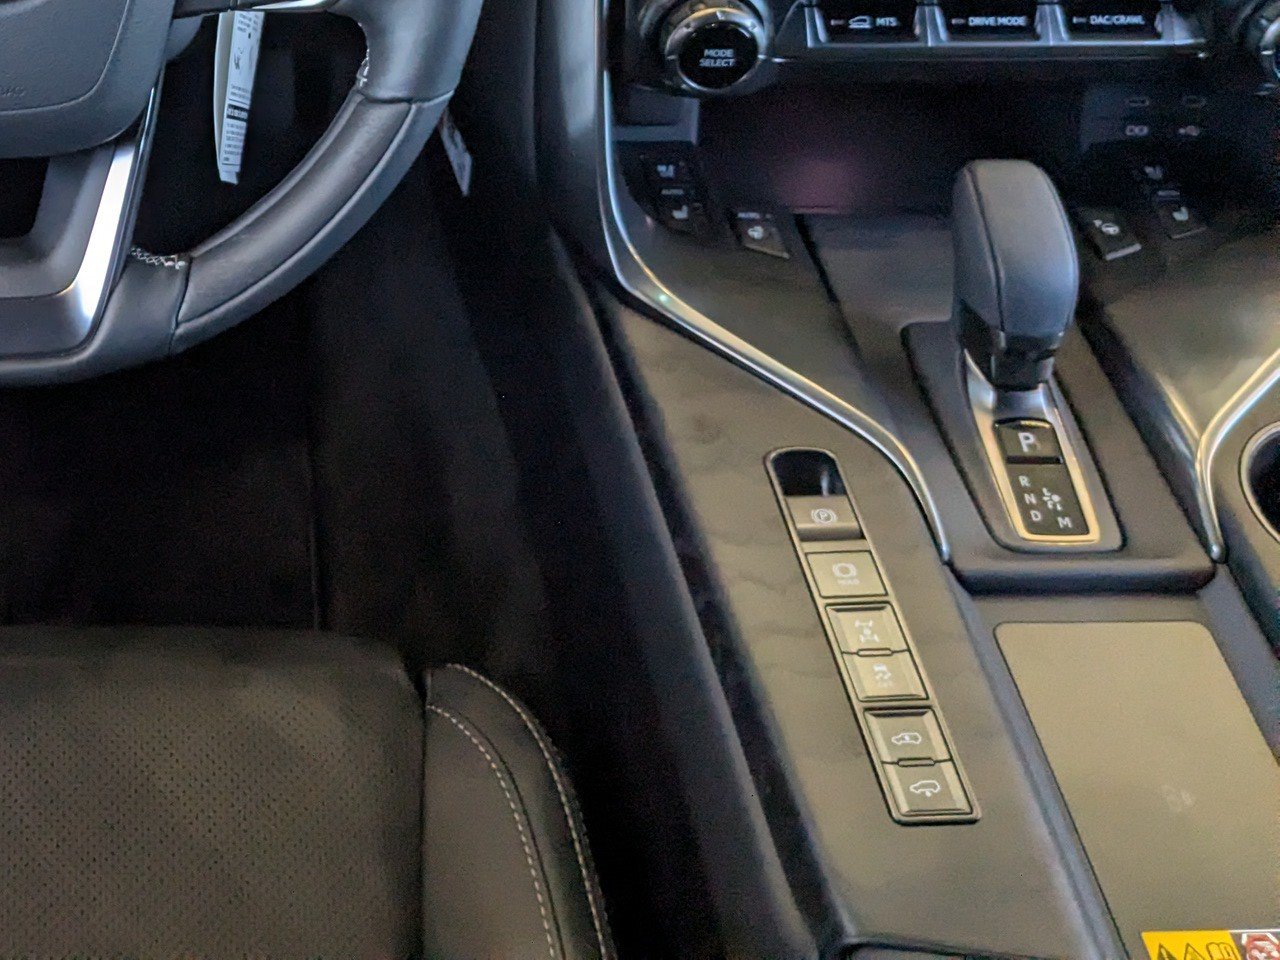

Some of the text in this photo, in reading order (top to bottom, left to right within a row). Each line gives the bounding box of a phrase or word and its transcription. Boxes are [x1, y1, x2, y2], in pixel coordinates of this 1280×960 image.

[876, 17, 897, 27] MTS
[968, 16, 1026, 27] DRIVE MODE
[1089, 15, 1145, 26] DAC/CRAWL
[704, 48, 734, 57] MODE
[699, 58, 736, 67] SELECT
[1018, 432, 1036, 453] P
[1018, 475, 1031, 488] R
[1024, 493, 1037, 505] N
[1030, 510, 1042, 521] D
[1058, 516, 1073, 529] M
